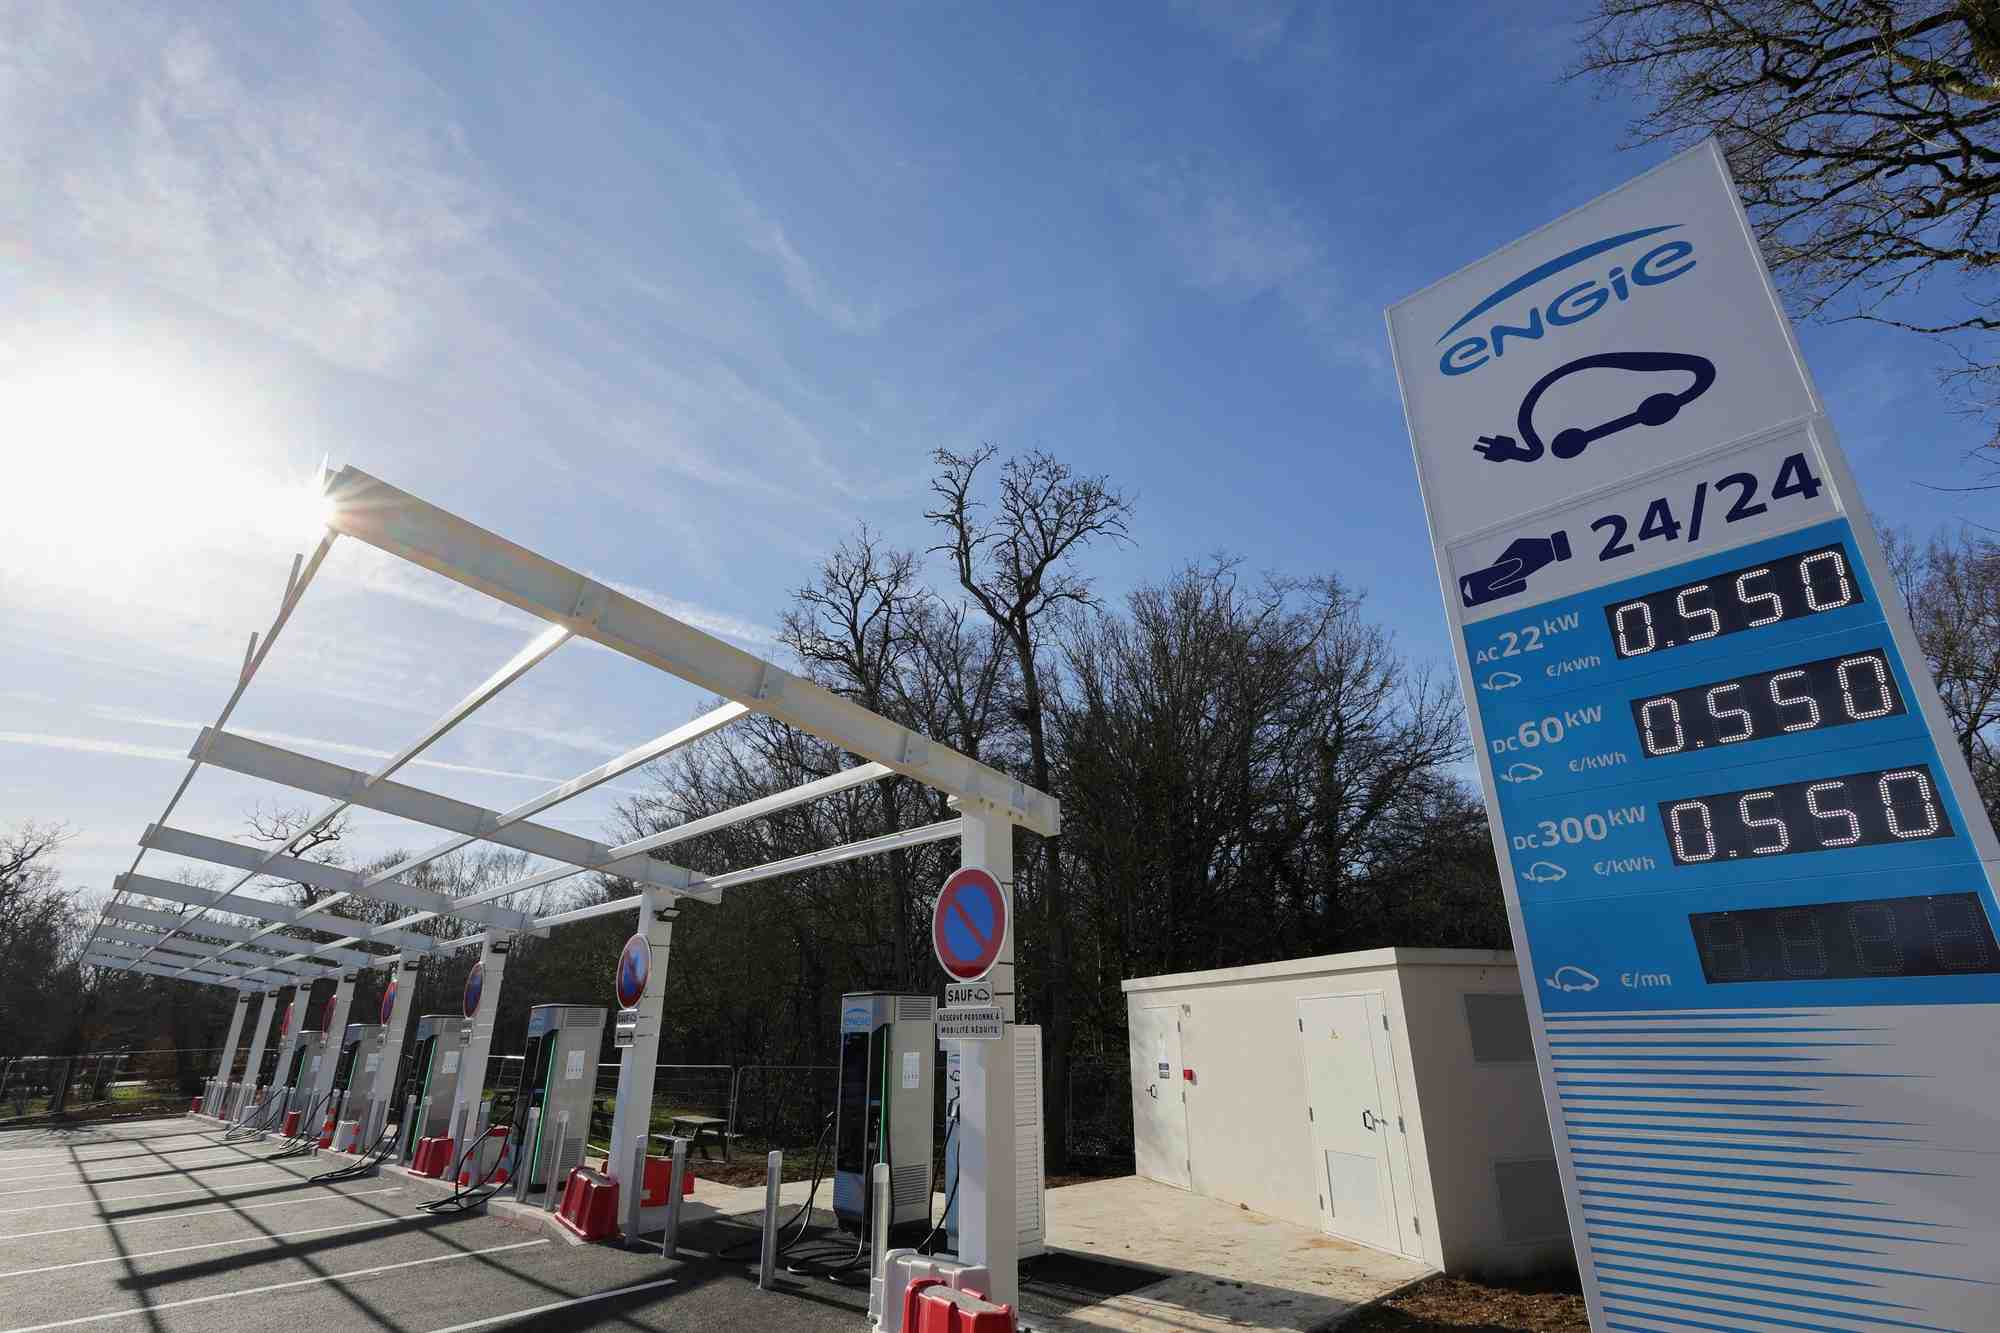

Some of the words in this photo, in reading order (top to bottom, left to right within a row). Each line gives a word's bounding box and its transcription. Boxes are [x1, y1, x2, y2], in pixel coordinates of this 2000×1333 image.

[1590, 452, 1823, 561] 24/24
[1615, 550, 1852, 657] 0.550
[1640, 655, 1893, 756] 0.550
[1568, 751, 1628, 773] €/kWh
[1669, 770, 1939, 863] 0.550
[1593, 855, 1656, 877] €/kWh
[947, 989, 972, 1002] SAUF
[1620, 971, 1673, 990] €/mn
